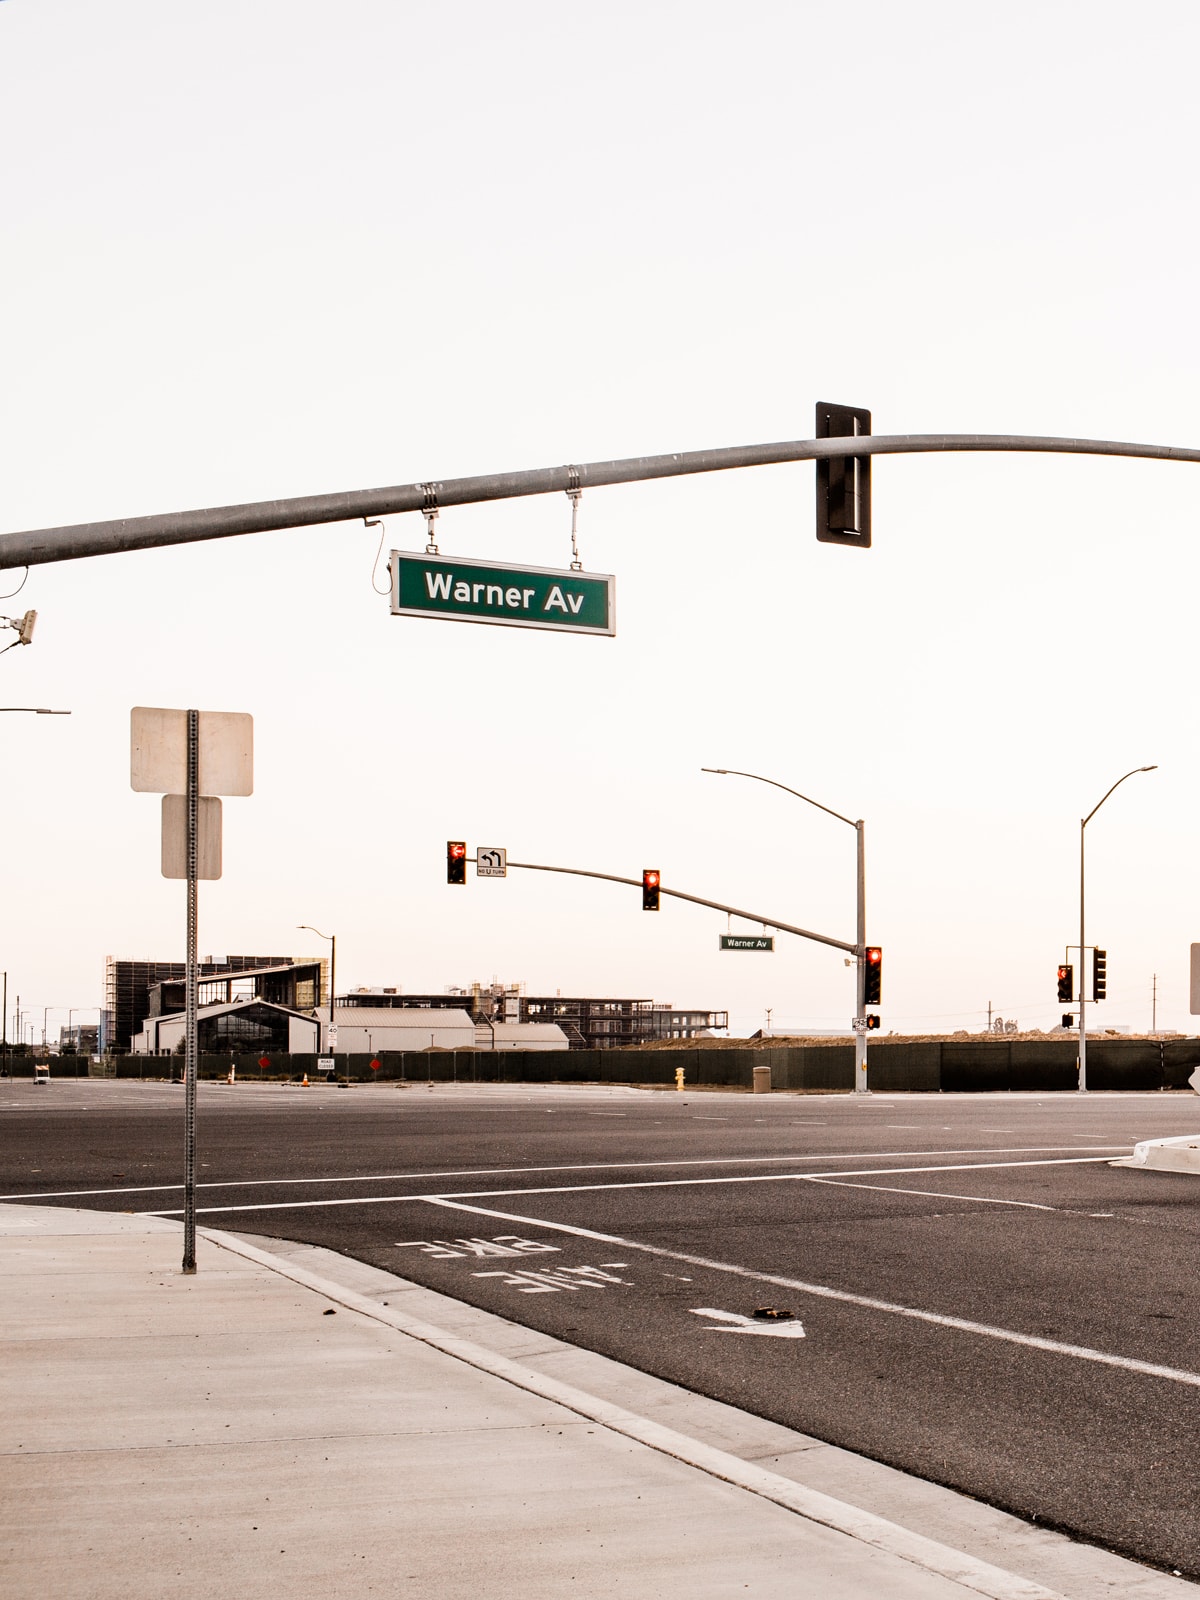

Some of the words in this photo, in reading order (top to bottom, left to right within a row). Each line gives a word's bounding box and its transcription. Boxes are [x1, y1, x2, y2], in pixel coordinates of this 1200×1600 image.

[425, 571, 535, 609] Warner
[544, 586, 584, 614] Av
[727, 939, 755, 948] Warner
[756, 940, 767, 948] Av
